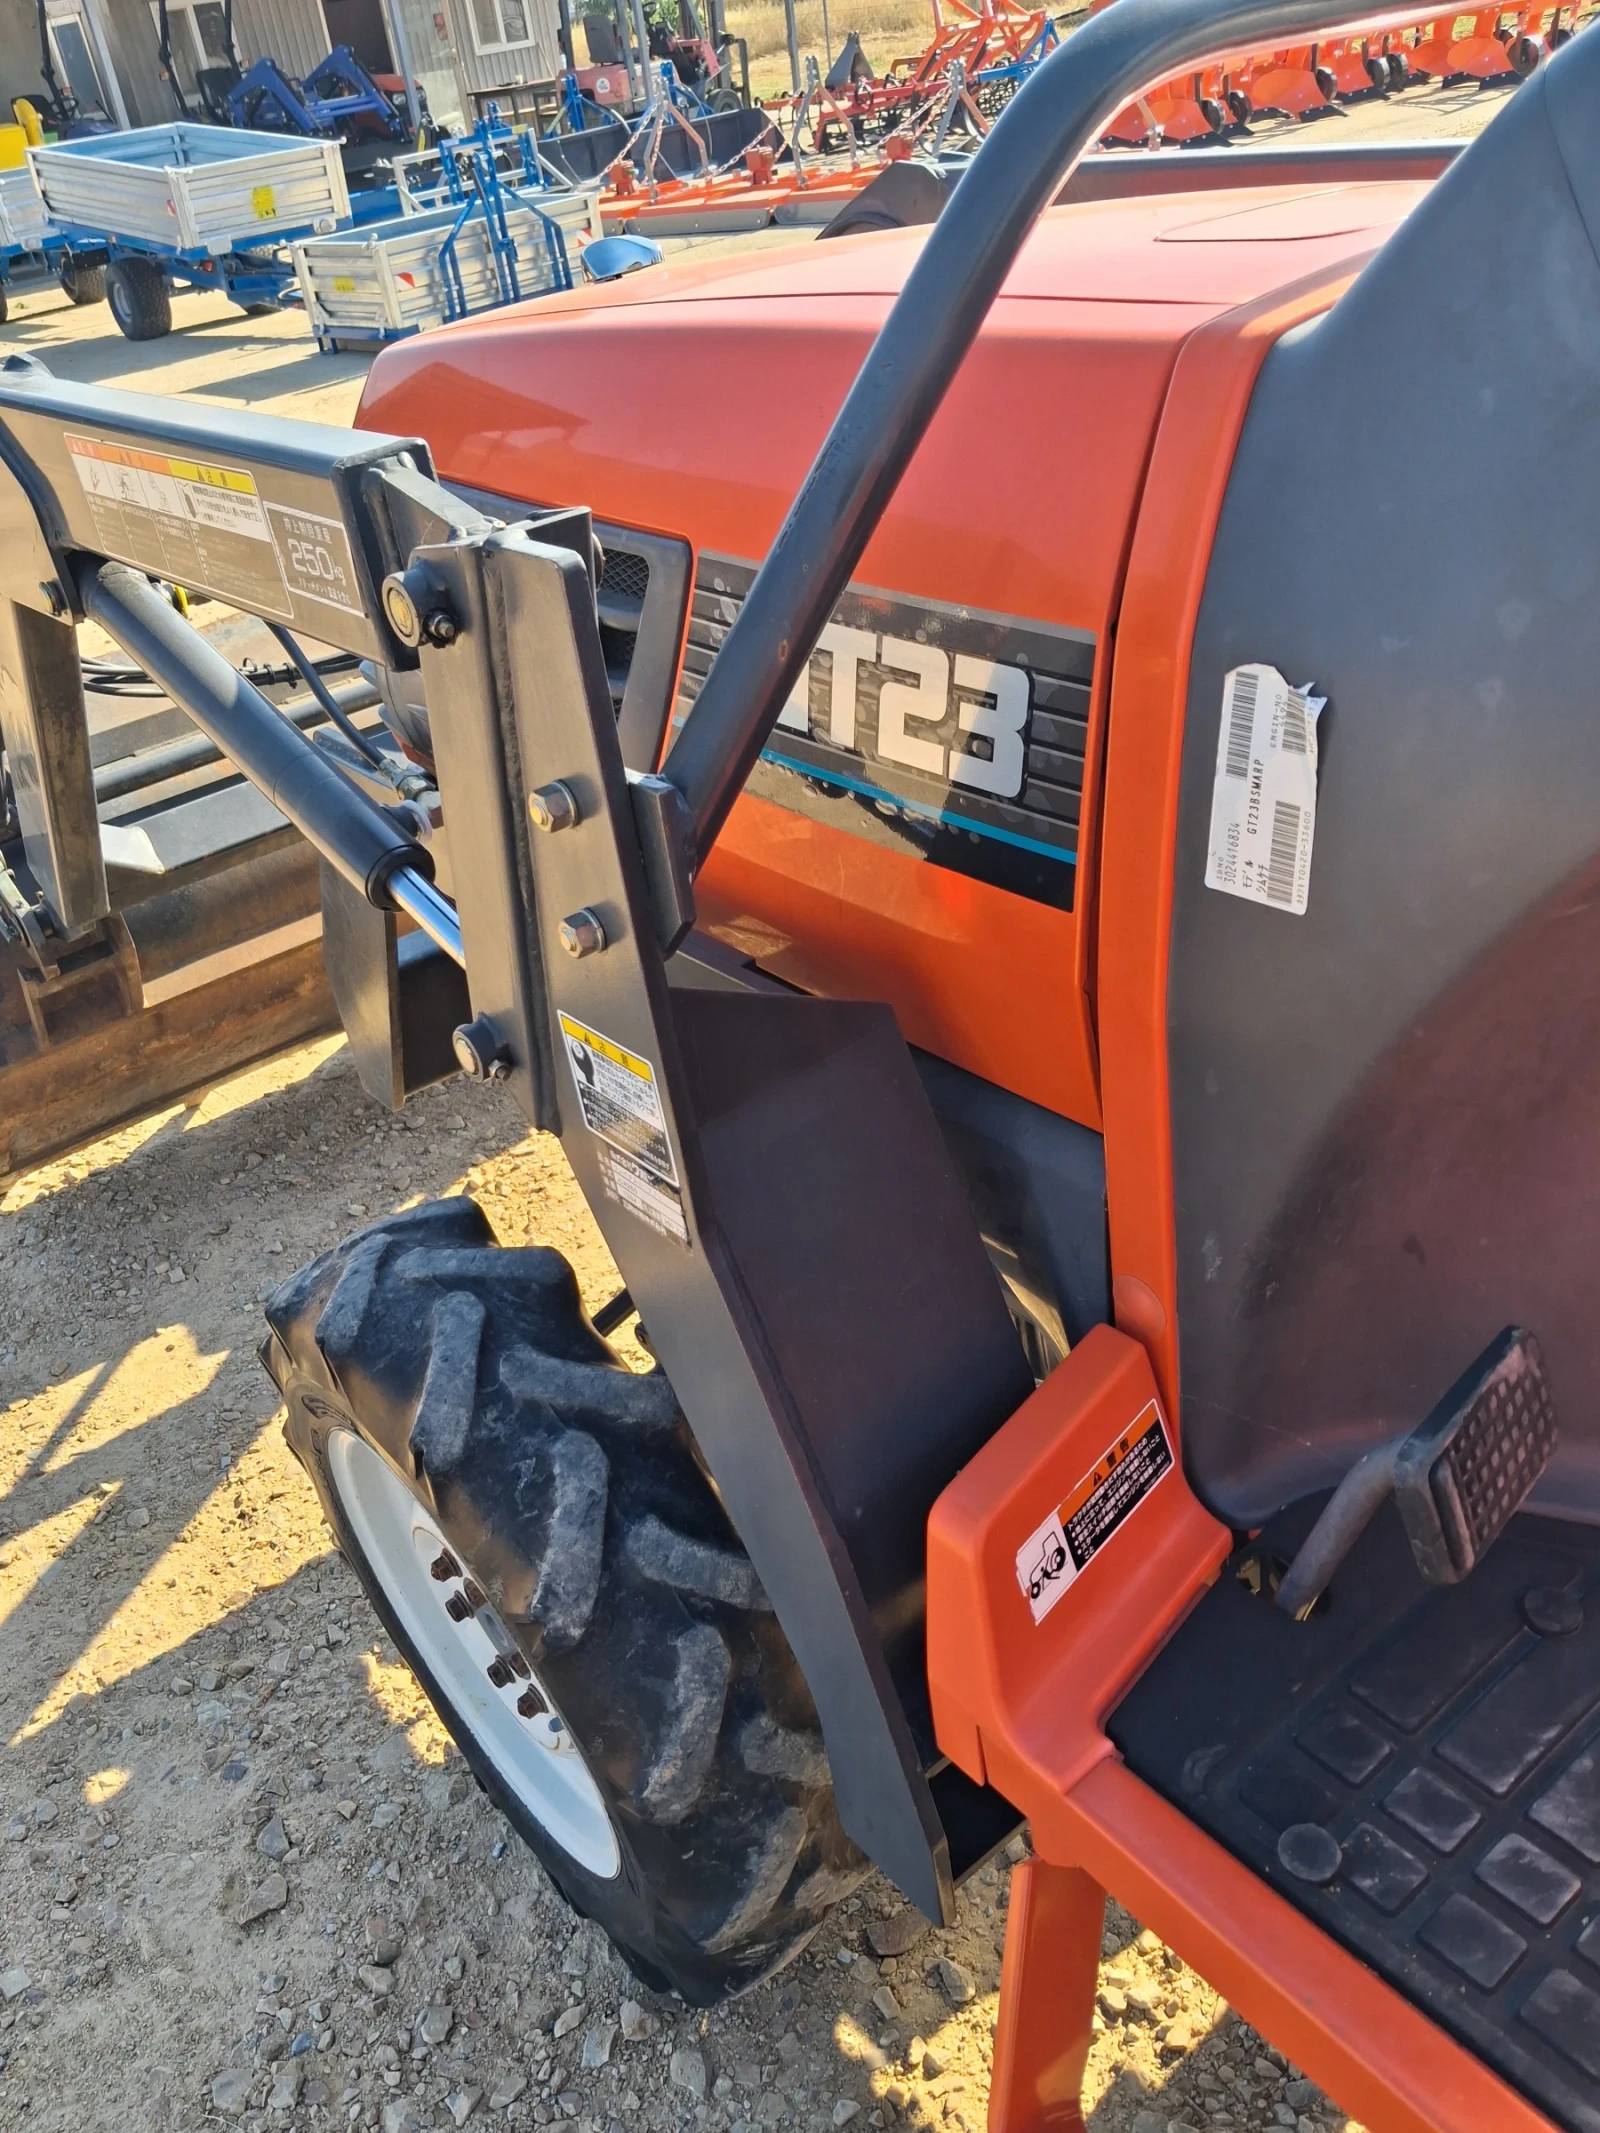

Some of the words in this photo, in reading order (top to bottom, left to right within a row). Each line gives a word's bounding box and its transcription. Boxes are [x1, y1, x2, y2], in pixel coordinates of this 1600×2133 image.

[287, 537, 348, 586] 250kg
[776, 622, 1030, 799] T23
[1247, 759, 1264, 835] GT23BSMARP
[1224, 822, 1241, 884] 3024416834
